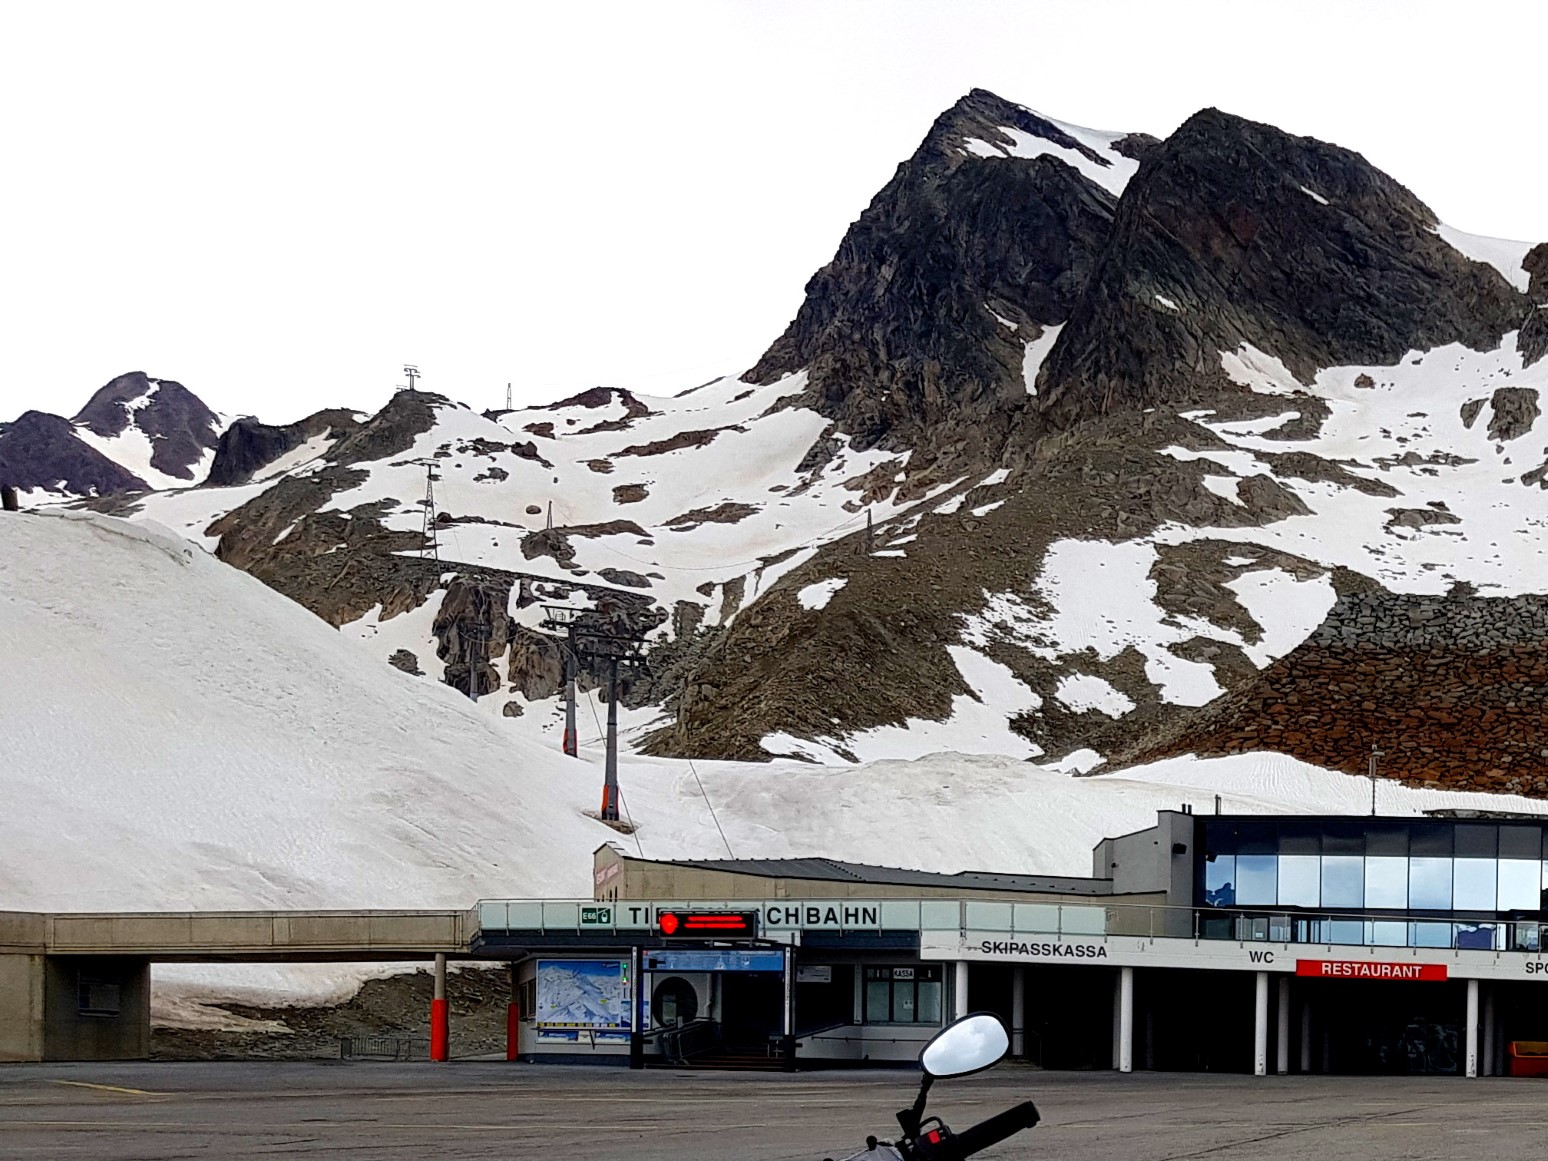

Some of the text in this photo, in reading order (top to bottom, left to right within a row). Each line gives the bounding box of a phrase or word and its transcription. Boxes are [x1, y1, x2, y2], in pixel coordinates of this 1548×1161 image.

[981, 940, 1108, 958] SKIPASSKASSA
[1249, 950, 1275, 964] WC
[1321, 962, 1422, 978] RESTAURANT
